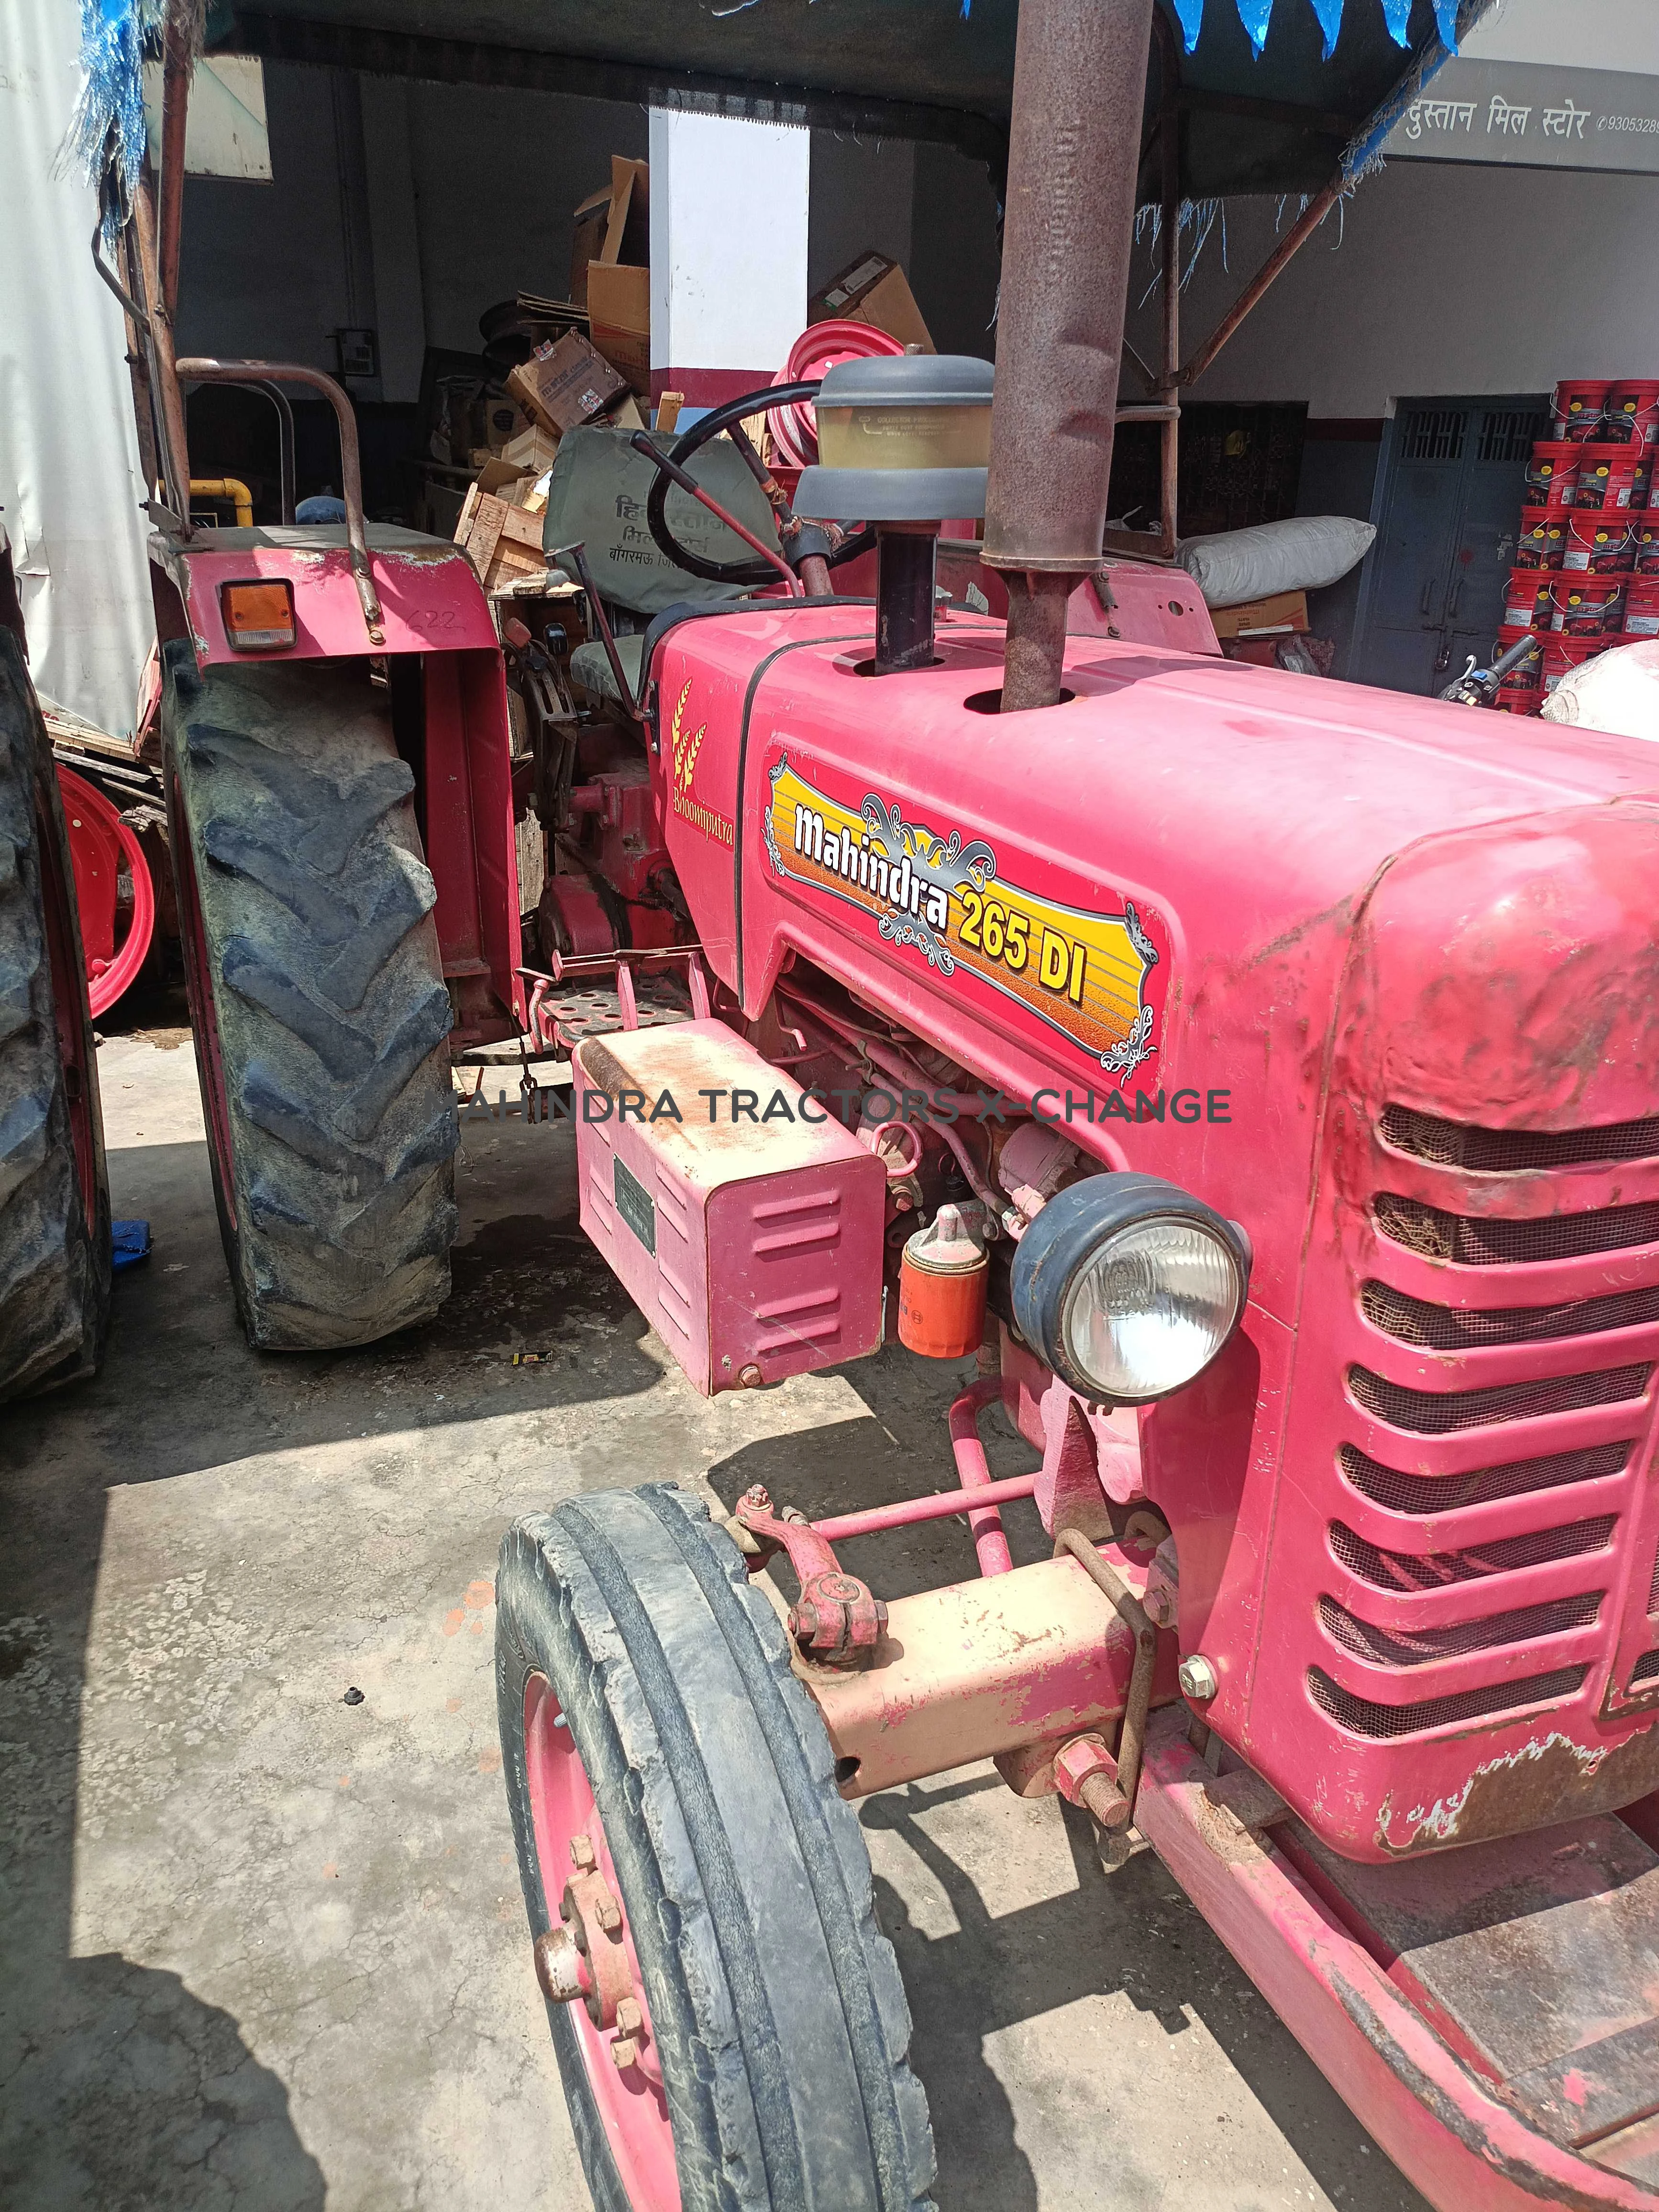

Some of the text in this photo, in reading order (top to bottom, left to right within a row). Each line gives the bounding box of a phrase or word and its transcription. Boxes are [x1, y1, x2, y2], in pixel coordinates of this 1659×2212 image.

[1403, 99, 1477, 139] दुस्तान
[1486, 95, 1531, 135] मिल
[1543, 99, 1591, 139] स्टोर
[673, 786, 733, 846] Bhoomiputra
[959, 891, 1031, 969] 265
[1039, 929, 1088, 1003] DI
